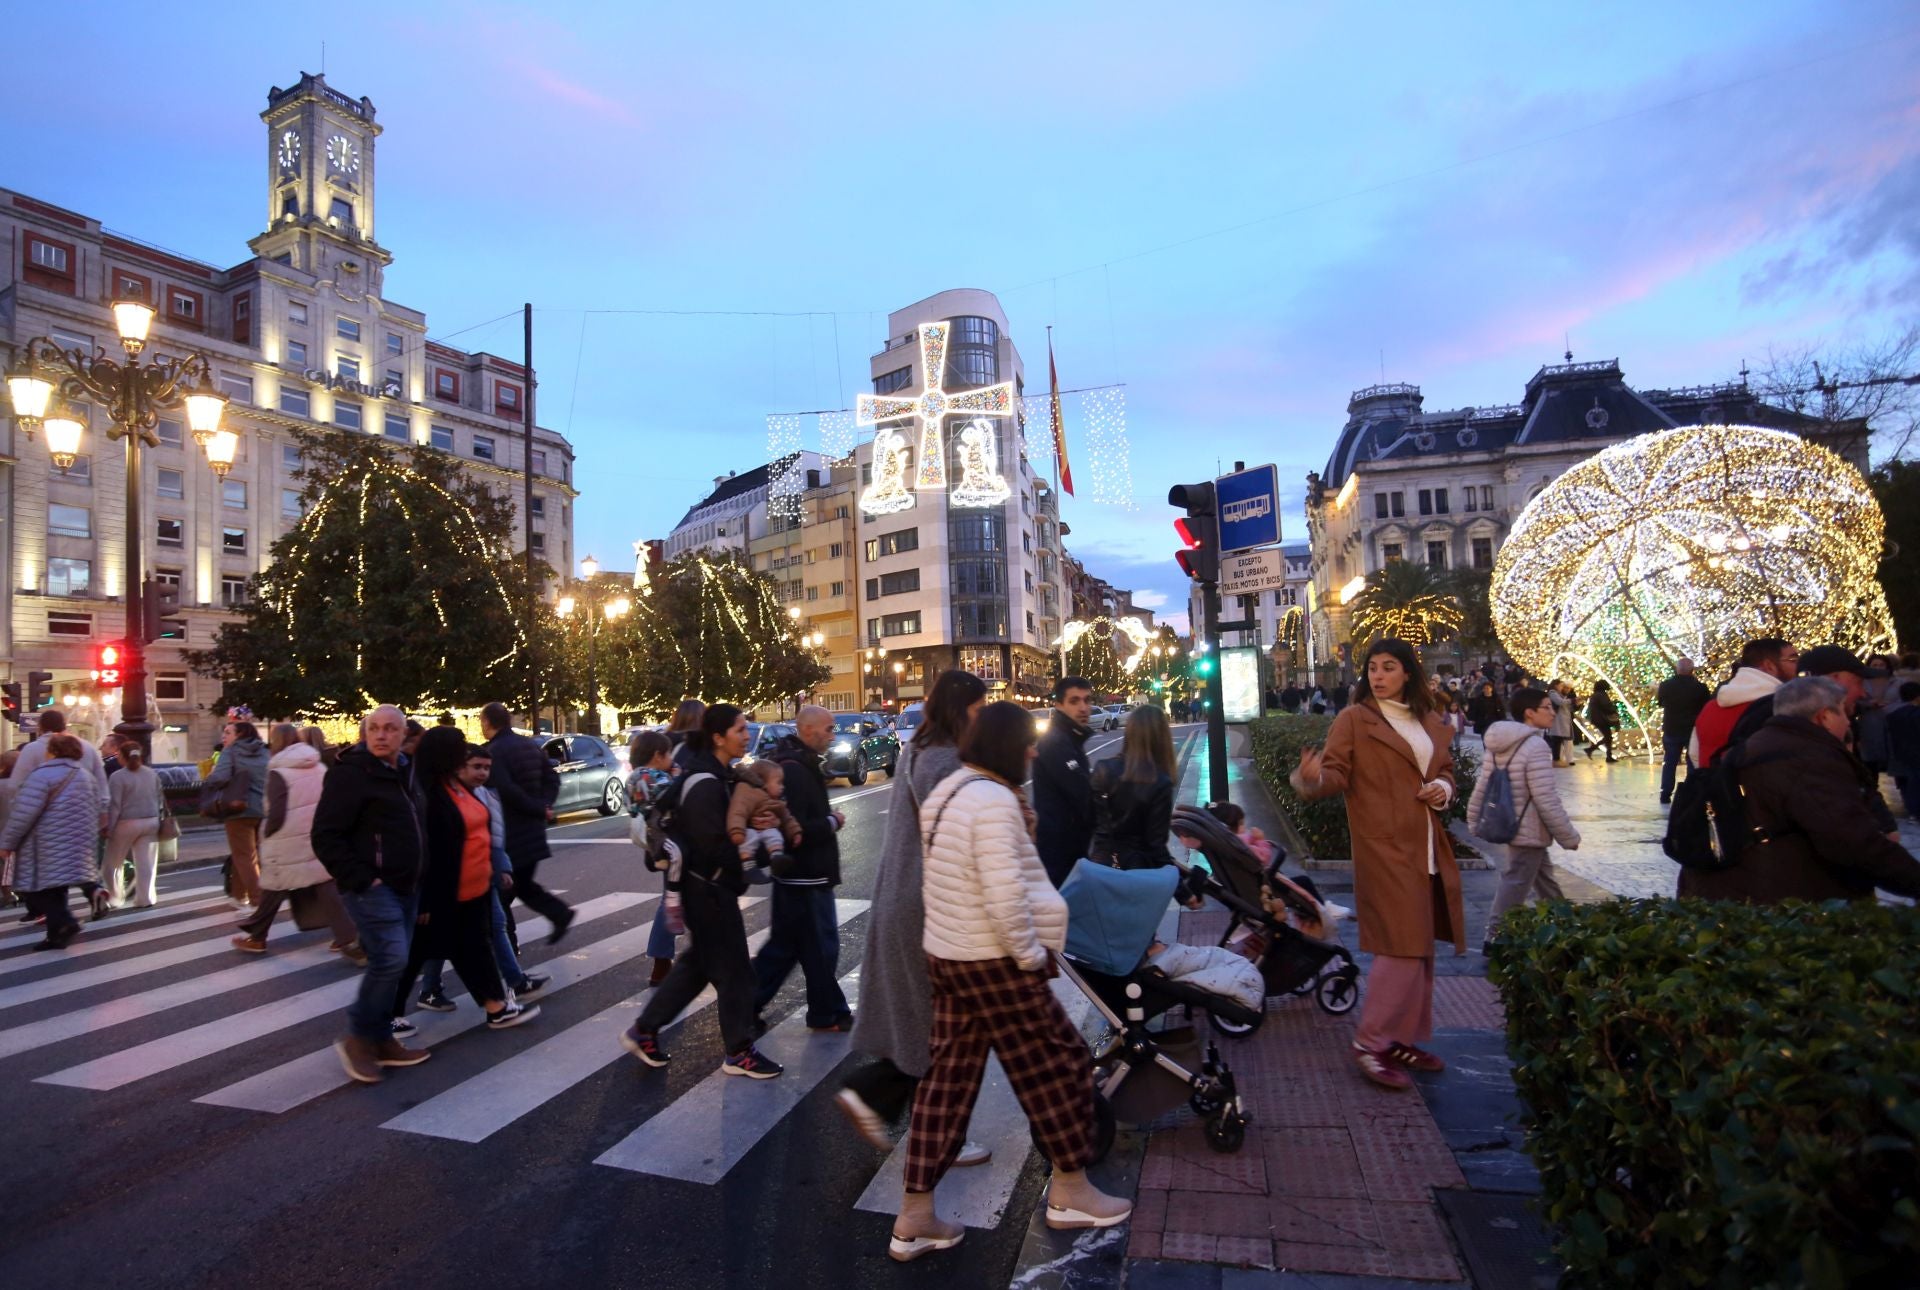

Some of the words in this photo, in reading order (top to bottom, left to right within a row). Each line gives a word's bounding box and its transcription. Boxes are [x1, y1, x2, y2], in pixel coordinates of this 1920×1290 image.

[1238, 556, 1261, 567] EXCEPTO
[1233, 570, 1244, 579] BUS
[1246, 566, 1268, 577] URBANO
[1266, 576, 1280, 585] BICIS
